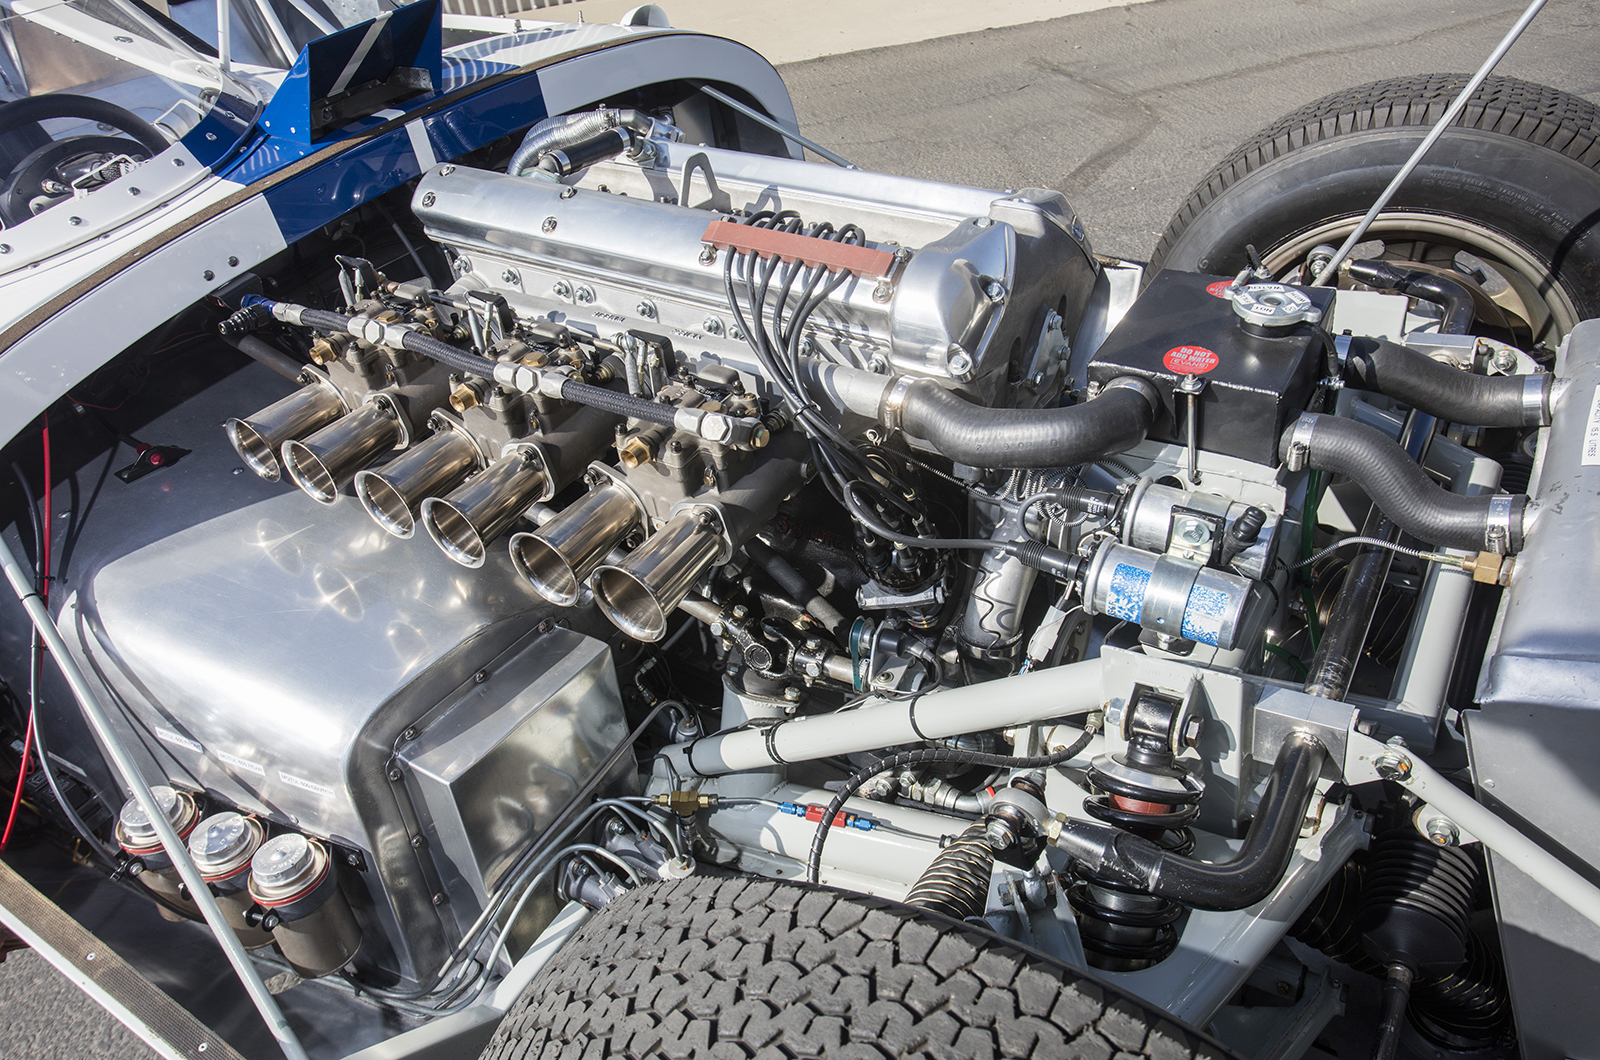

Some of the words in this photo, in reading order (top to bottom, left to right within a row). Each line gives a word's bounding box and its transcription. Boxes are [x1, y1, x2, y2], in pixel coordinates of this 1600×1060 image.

[1254, 305, 1273, 313] NOT
[1170, 351, 1188, 359] ADD
[1188, 355, 1216, 364] WATER
[1180, 347, 1194, 355] DO
[1193, 350, 1213, 358] NOT
[1587, 439, 1598, 457] LITRES
